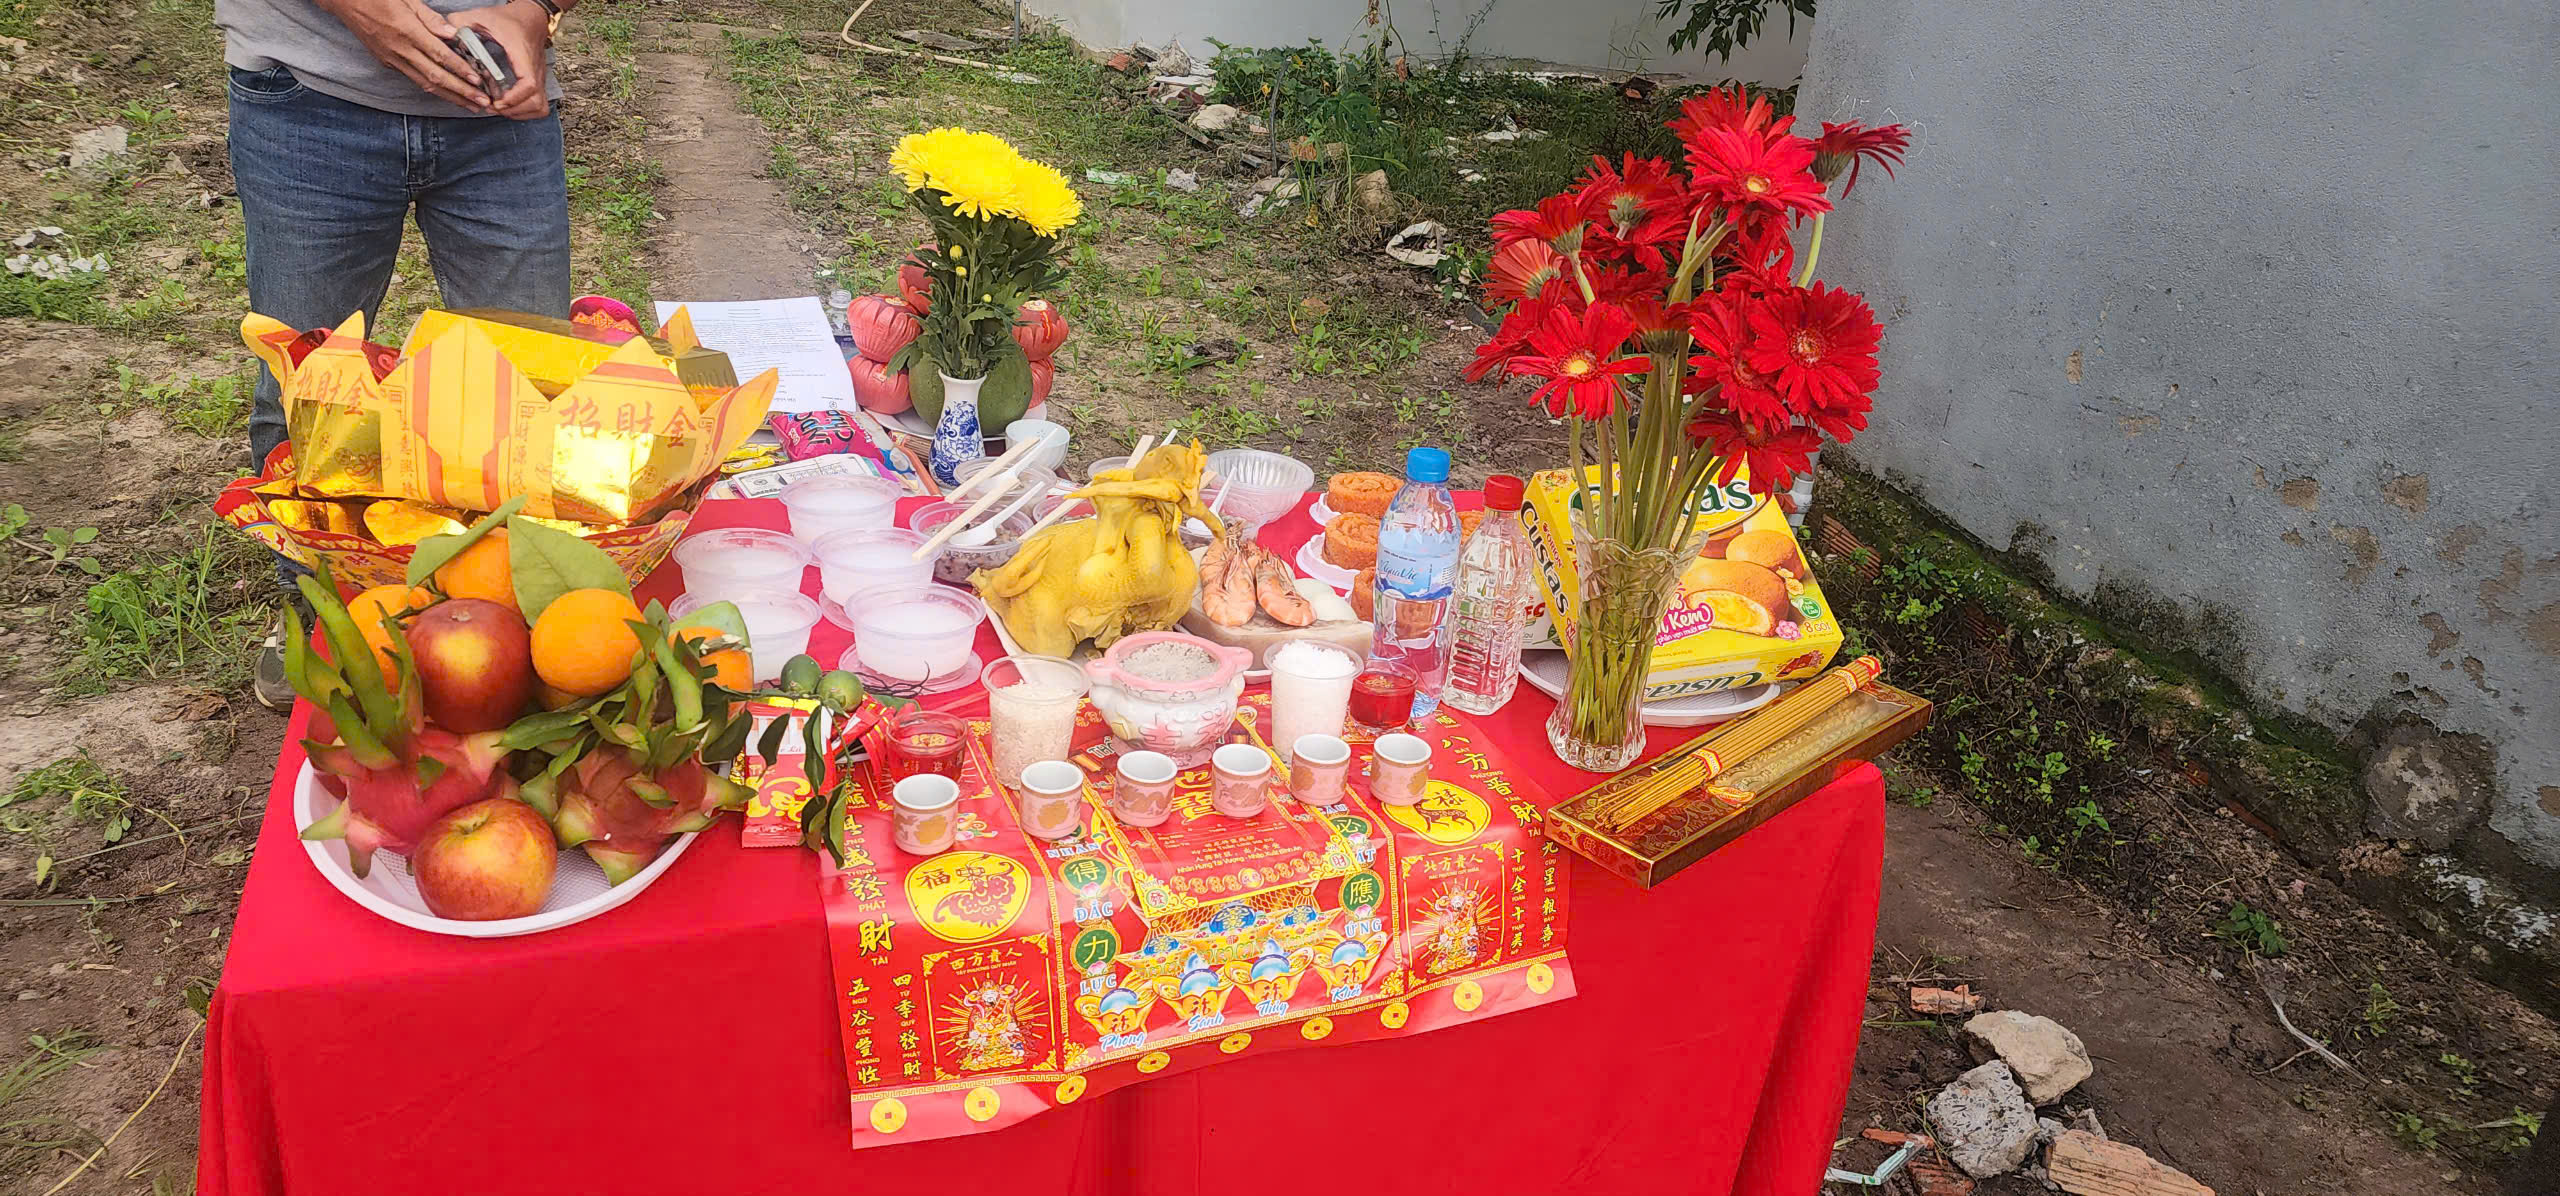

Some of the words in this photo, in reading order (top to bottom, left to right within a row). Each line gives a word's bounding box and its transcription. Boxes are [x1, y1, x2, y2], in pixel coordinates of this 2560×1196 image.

[1520, 500, 1570, 617] Custas
[1546, 531, 1563, 568] ORION
[1668, 605, 1711, 631] Kem
[1803, 621, 1813, 632] 8
[1528, 827, 1541, 838] TÀI
[916, 868, 951, 890] 福
[1070, 860, 1100, 883] 得
[858, 899, 887, 913] PHÁT
[1074, 901, 1113, 922] ĐẮC
[859, 912, 896, 957] 財
[1345, 919, 1383, 938] ỨNG
[1083, 935, 1109, 964] 力
[871, 956, 889, 967] TÀI
[1080, 973, 1117, 995] LỰC
[1188, 1011, 1225, 1033] Sanh
[1099, 1032, 1146, 1051] Phong
